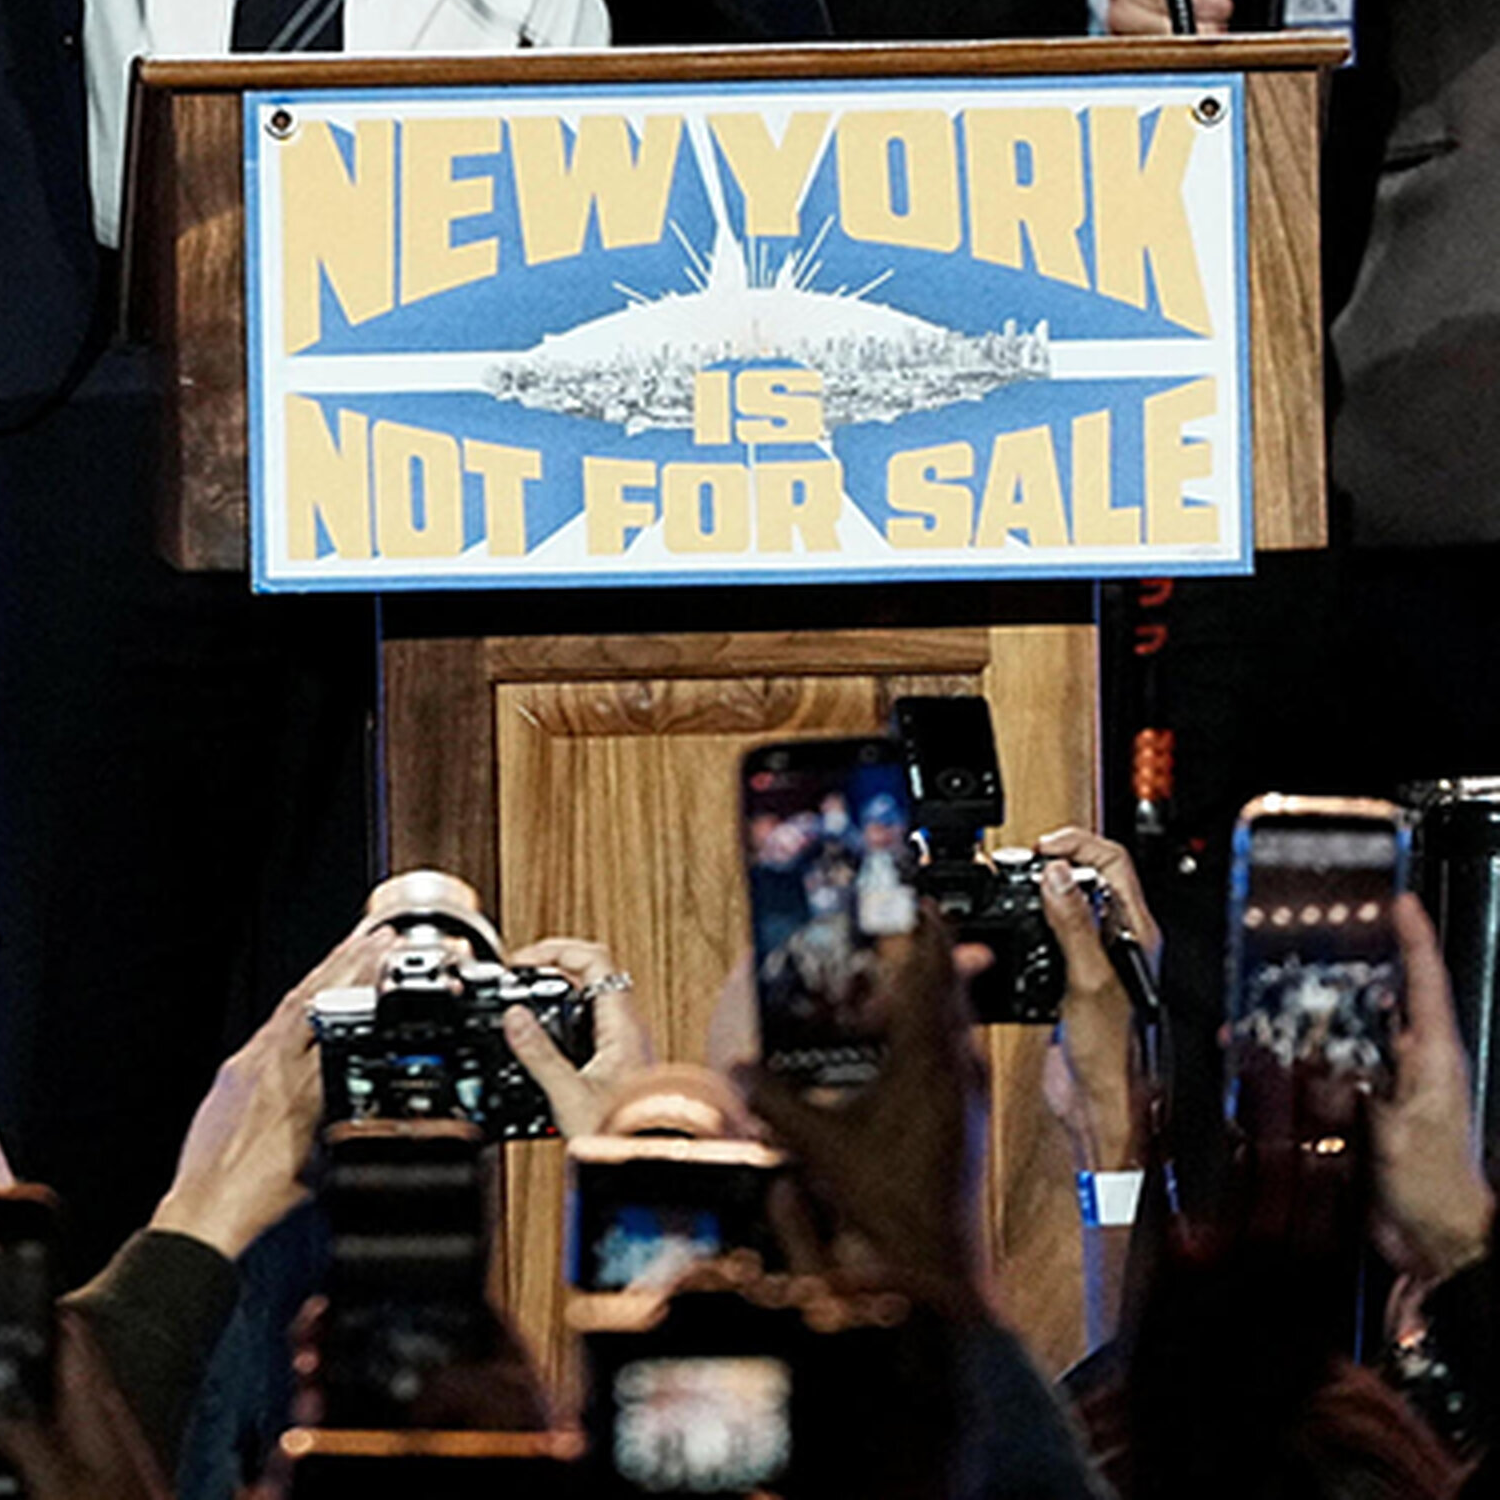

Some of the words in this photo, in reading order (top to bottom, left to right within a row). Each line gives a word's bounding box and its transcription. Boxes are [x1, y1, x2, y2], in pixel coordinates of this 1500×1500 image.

[280, 114, 684, 356] NEW
[707, 104, 1214, 339] YORK
[284, 392, 542, 561] NOT
[583, 456, 844, 557] FOR
[885, 375, 1221, 551] SALE
[693, 367, 825, 446] IS
